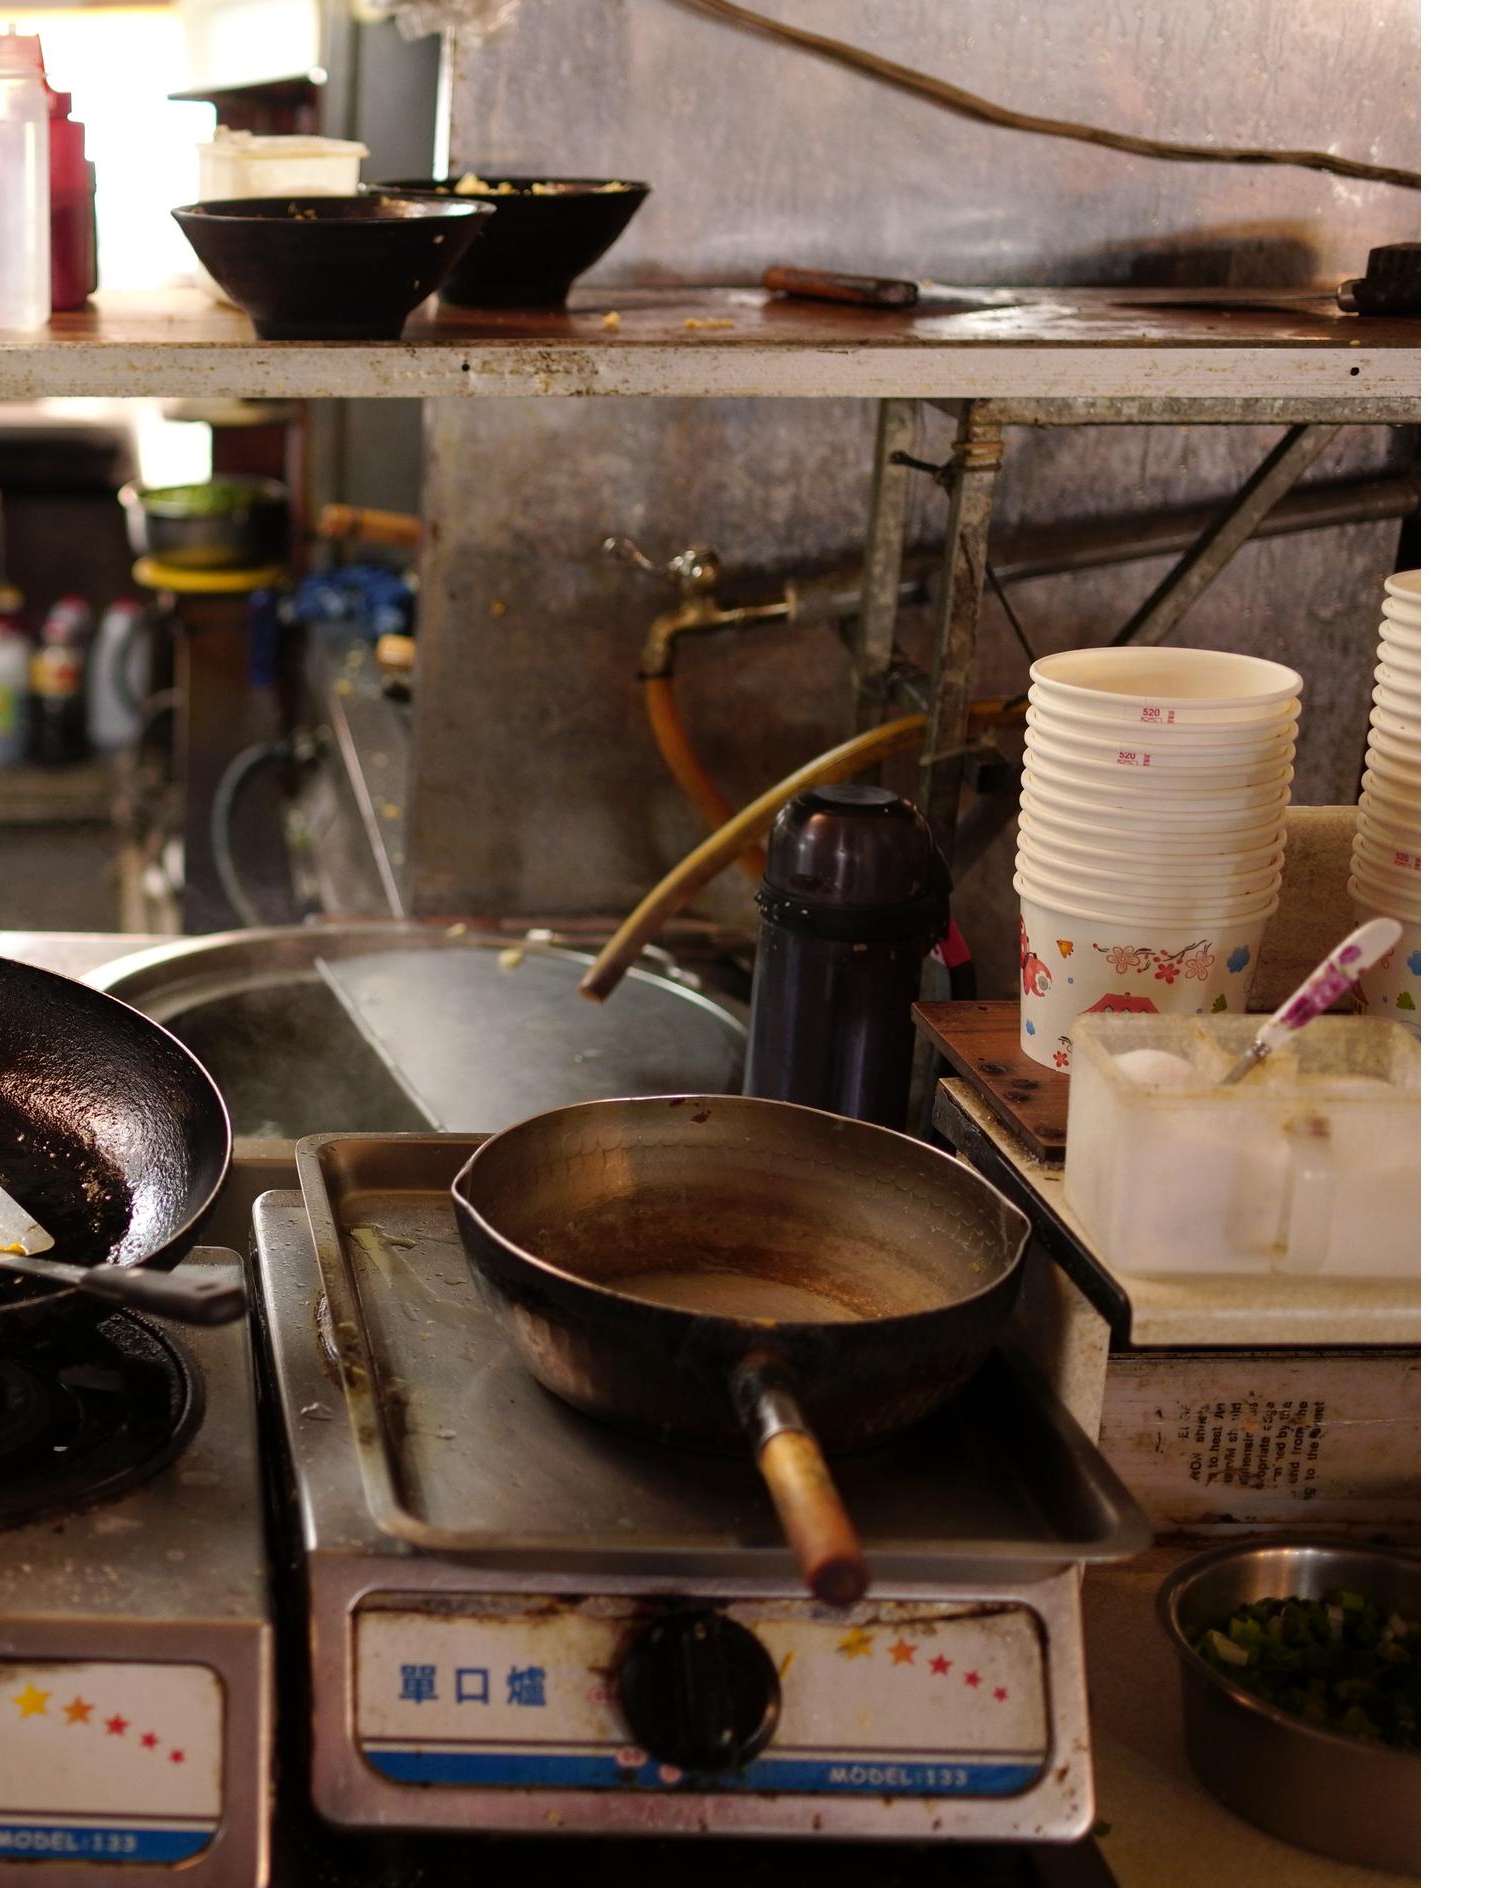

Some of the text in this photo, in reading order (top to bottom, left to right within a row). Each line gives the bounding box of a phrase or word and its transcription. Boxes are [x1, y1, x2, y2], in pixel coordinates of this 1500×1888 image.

[1142, 707, 1161, 717] 520
[1277, 1425, 1290, 1439] by
[1307, 1441, 1319, 1461] the
[1208, 1456, 1219, 1469] to
[1305, 1468, 1316, 1480] to
[399, 1664, 546, 1706] 單口爐
[828, 1765, 968, 1787] MODEL:133
